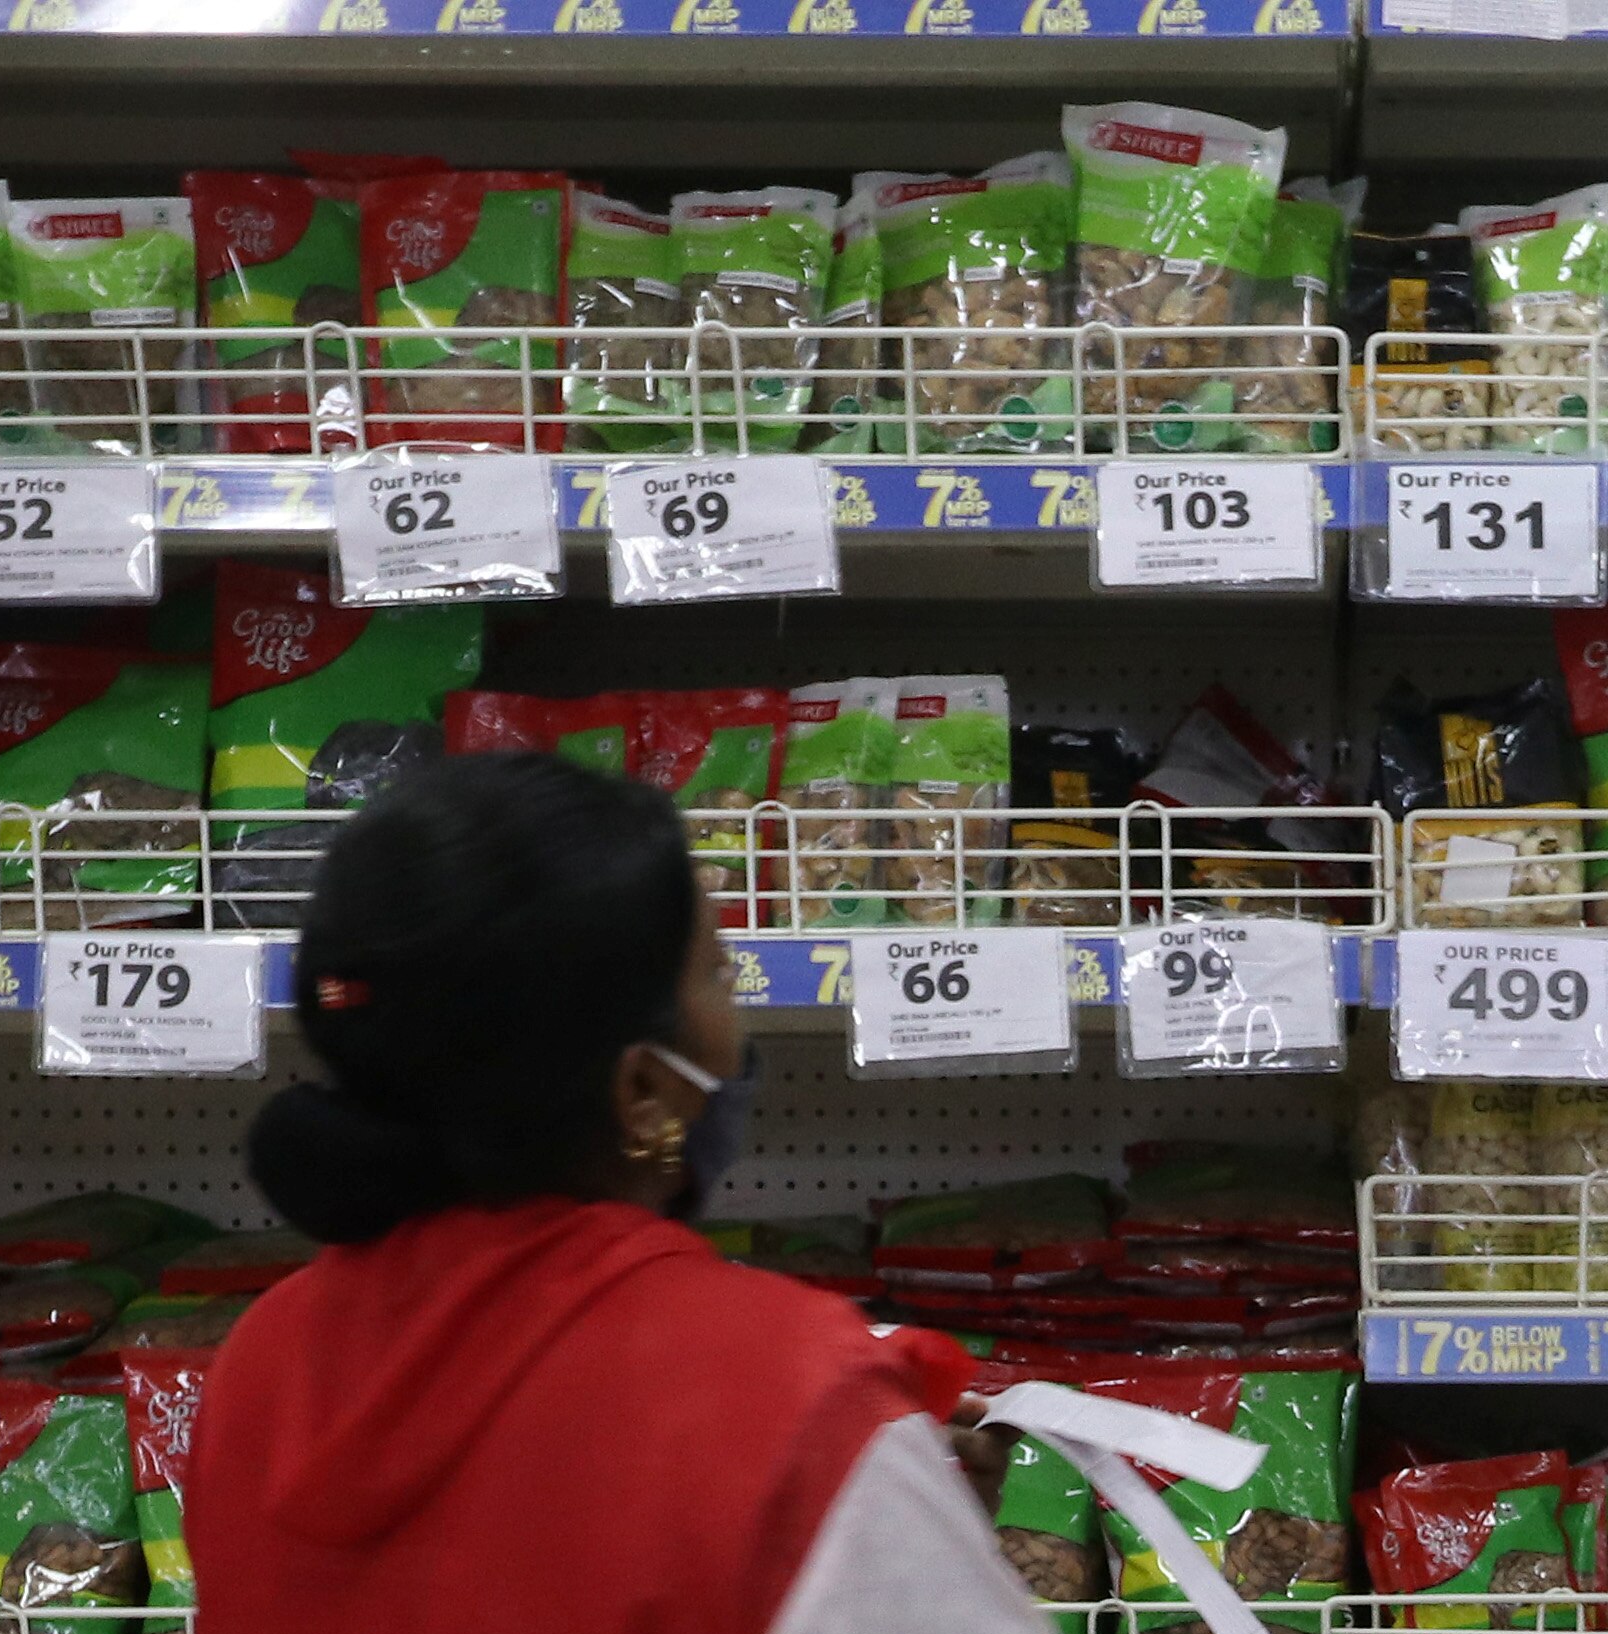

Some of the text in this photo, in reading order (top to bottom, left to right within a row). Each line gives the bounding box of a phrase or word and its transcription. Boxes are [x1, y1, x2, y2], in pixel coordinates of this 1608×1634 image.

[1119, 131, 1198, 160] SHREE
[16, 478, 66, 495] Price
[368, 469, 462, 492] Our Price
[643, 470, 736, 495] Our Price
[1134, 471, 1227, 490] Our Price
[1397, 472, 1511, 488] Our Price
[234, 608, 315, 640] Good
[248, 640, 309, 672] Life
[1159, 925, 1247, 946] Our Price
[84, 942, 175, 960] Our Price
[887, 940, 979, 959] Our Price
[1444, 945, 1559, 962] OUR PRICE
[1413, 1322, 1562, 1374] 7% BELOW
[1493, 1347, 1568, 1373] MRP
